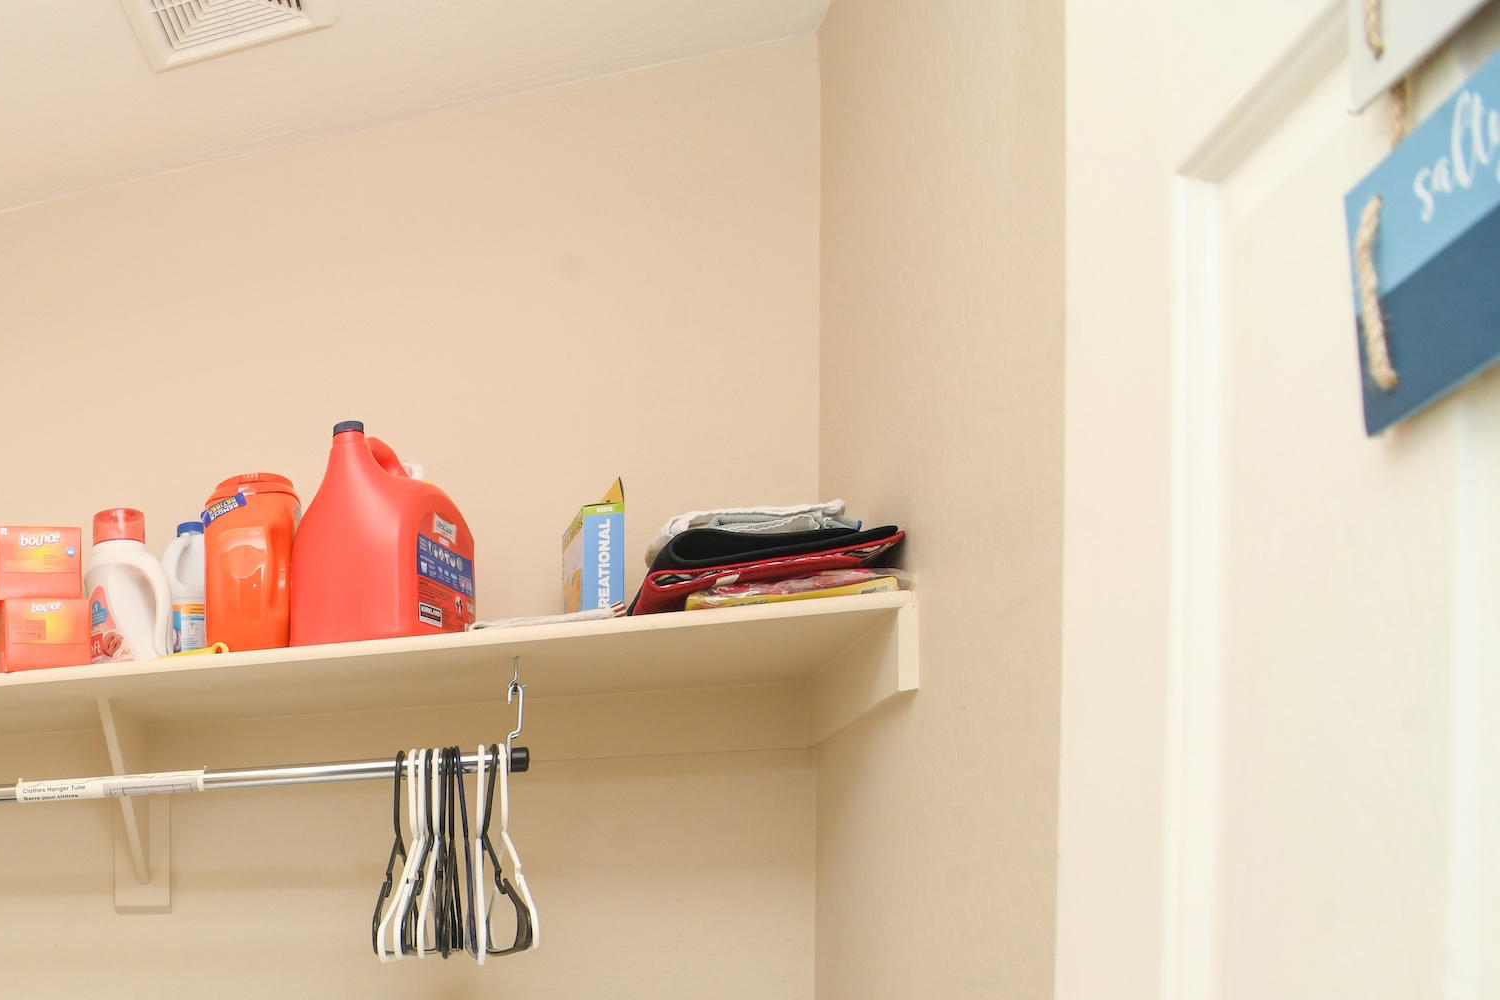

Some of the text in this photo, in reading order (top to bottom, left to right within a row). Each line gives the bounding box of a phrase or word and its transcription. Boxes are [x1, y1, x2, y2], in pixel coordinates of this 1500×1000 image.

[19, 531, 62, 548] bounce
[31, 602, 62, 613] bounce
[47, 785, 69, 794] Hanger
